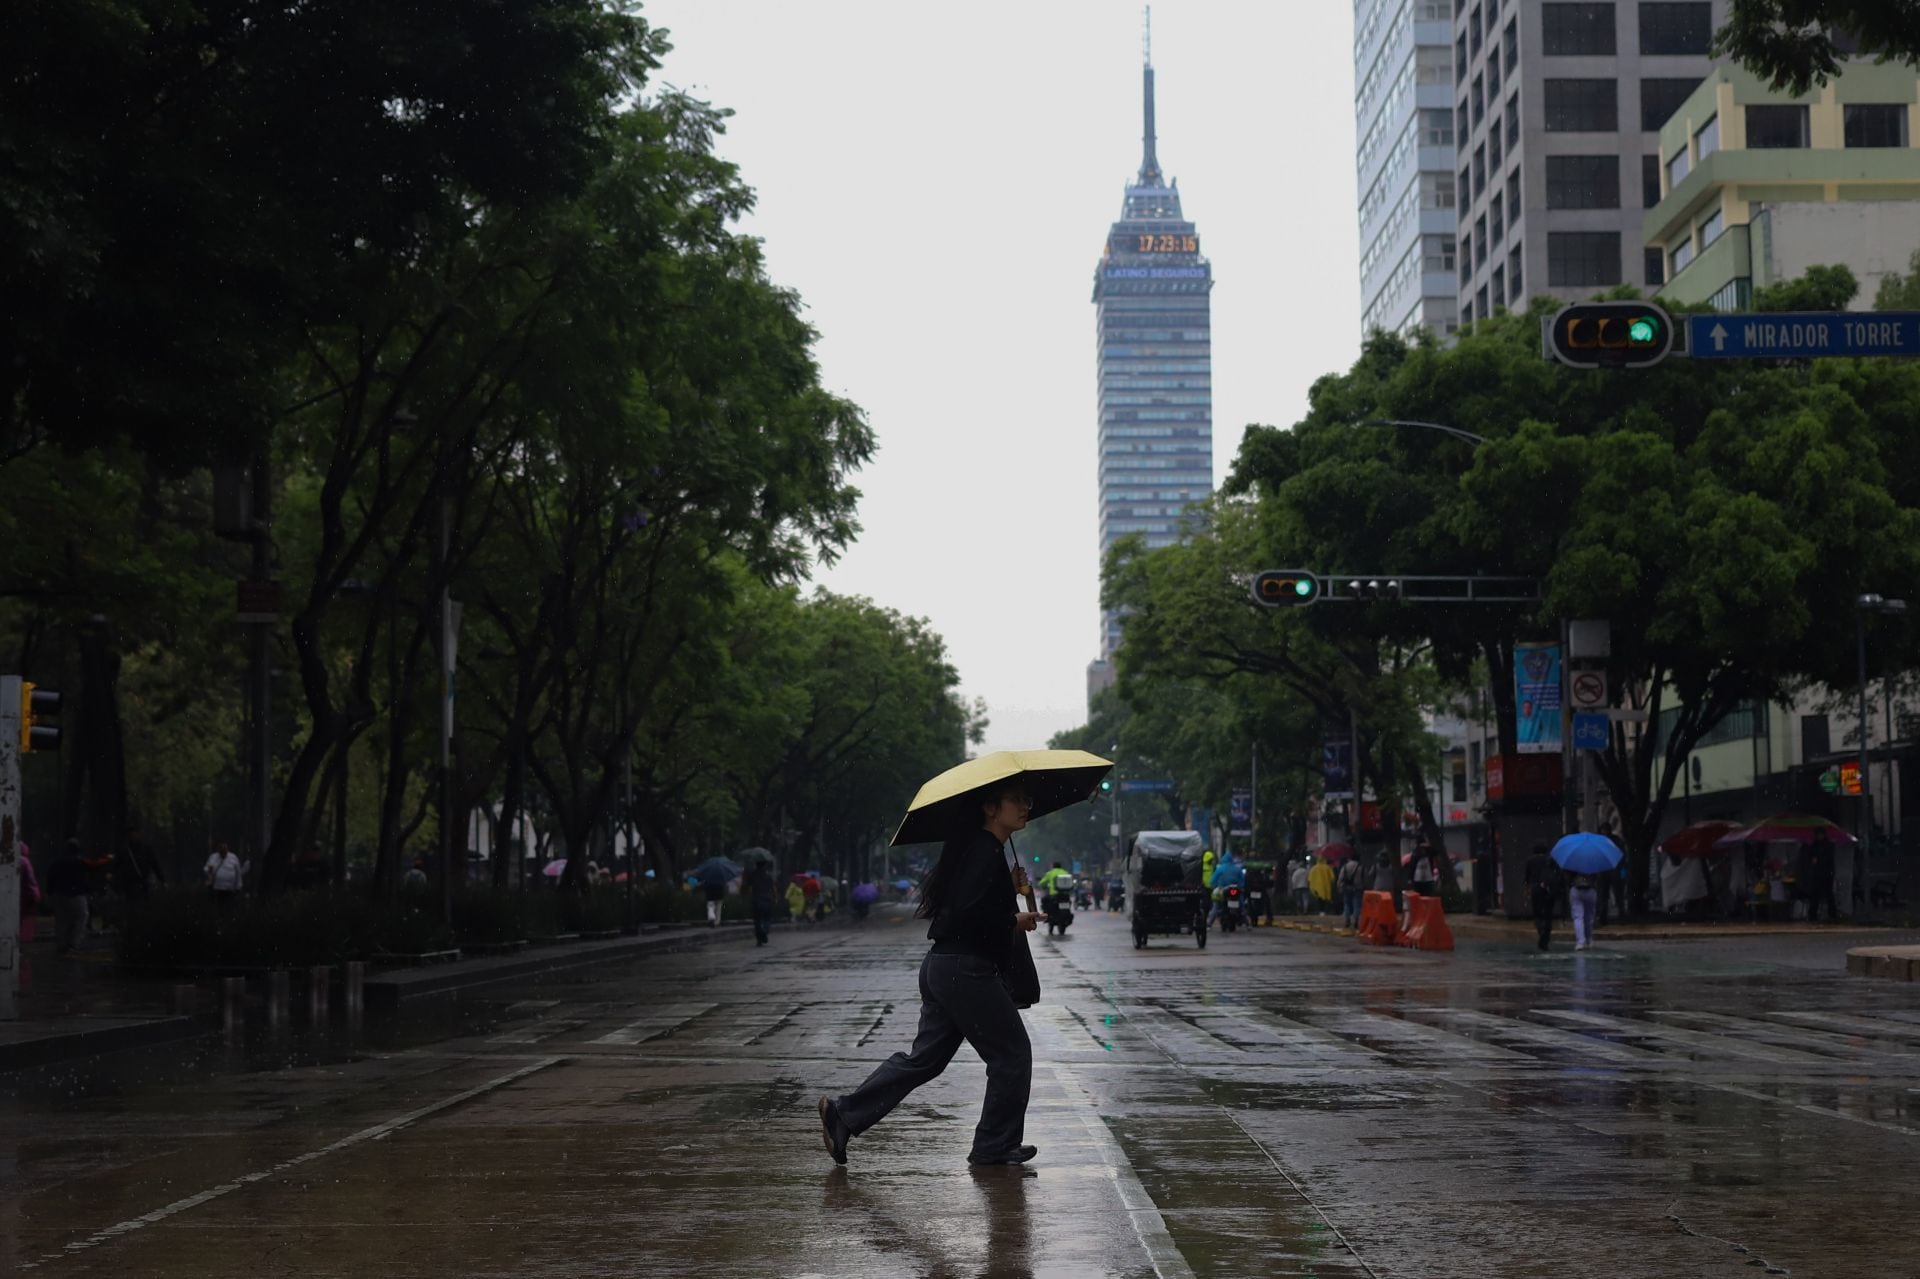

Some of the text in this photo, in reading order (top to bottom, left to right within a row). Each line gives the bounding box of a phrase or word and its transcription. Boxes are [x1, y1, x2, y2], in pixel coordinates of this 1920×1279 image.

[1107, 267, 1205, 278] LATINO SEGUROS
[1744, 323, 1829, 348] MIRADOR
[1844, 322, 1904, 347] TORRE
